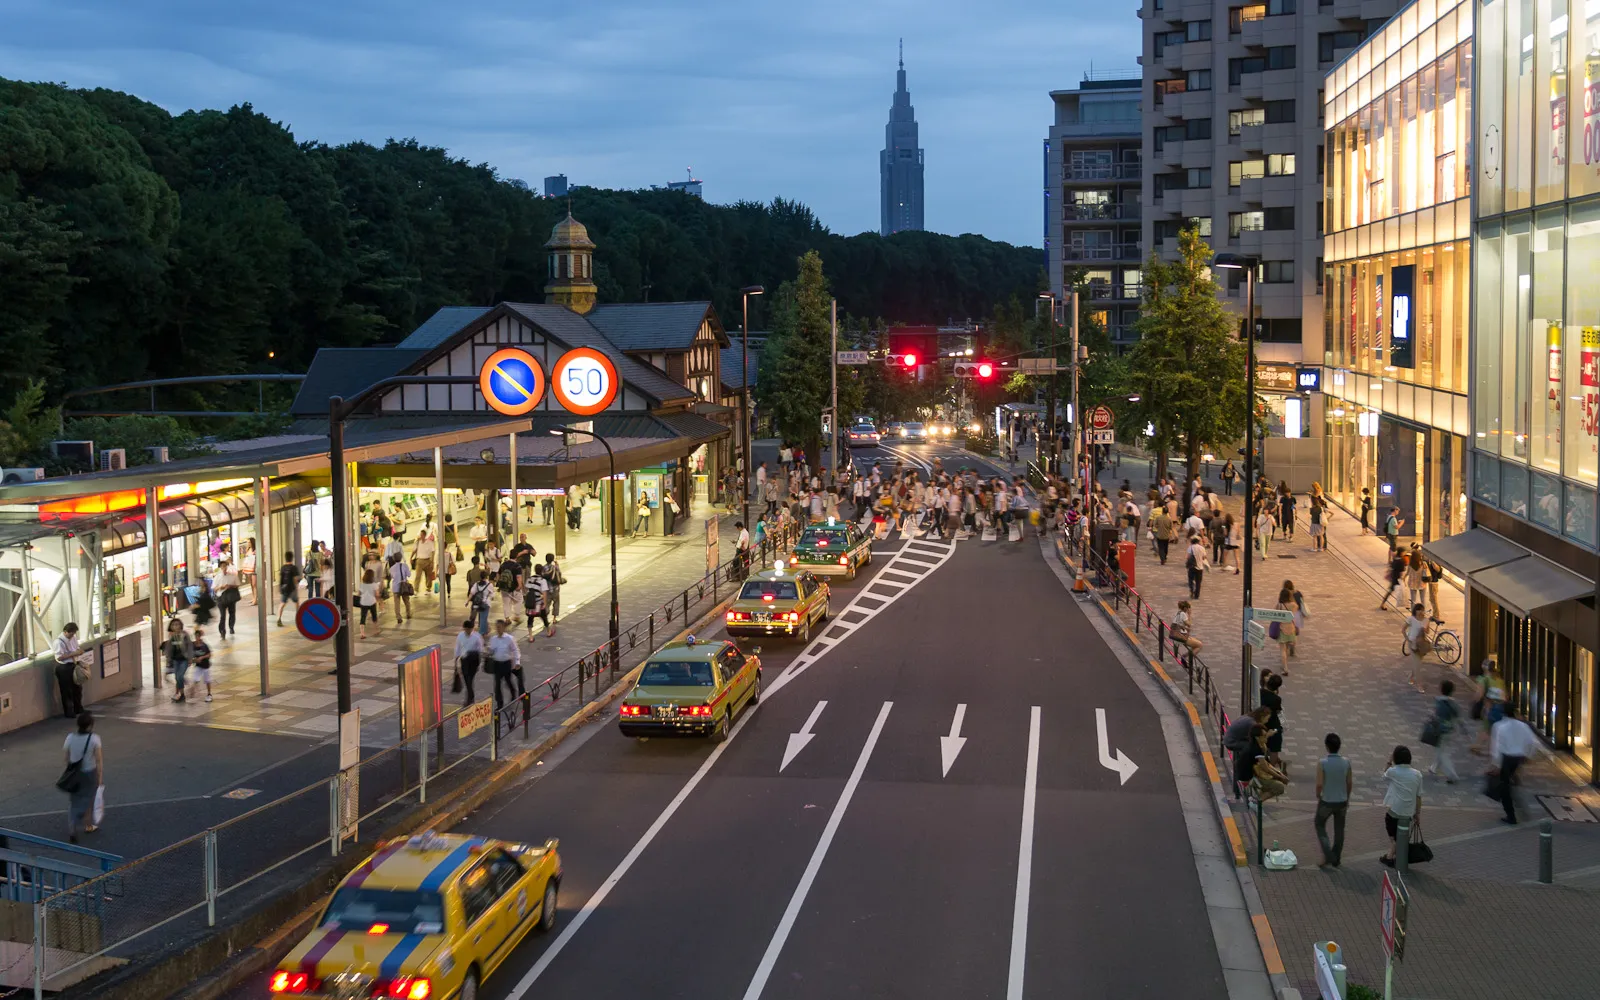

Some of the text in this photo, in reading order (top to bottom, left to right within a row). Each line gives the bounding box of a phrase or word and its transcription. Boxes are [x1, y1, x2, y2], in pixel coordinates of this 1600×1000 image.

[568, 368, 602, 395] 50
[1300, 374, 1316, 386] GAP
[379, 478, 389, 486] JR
